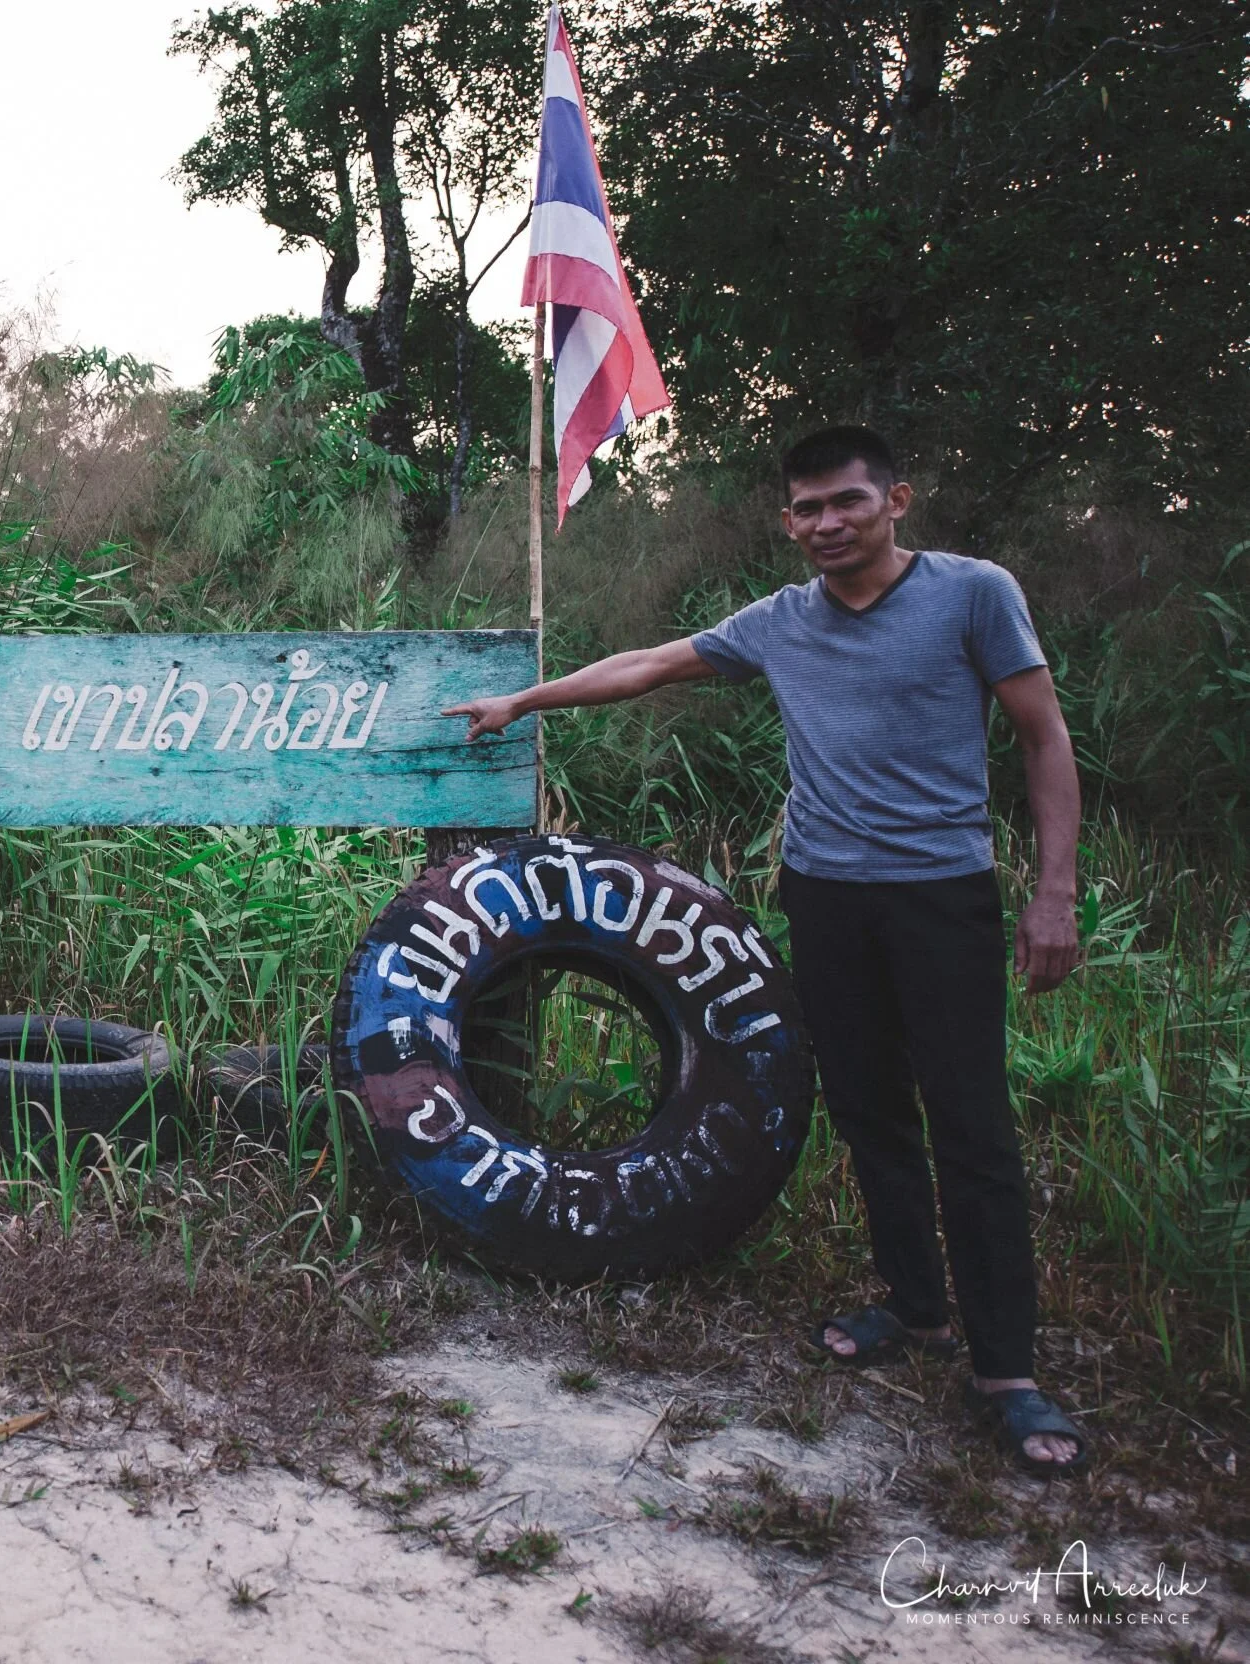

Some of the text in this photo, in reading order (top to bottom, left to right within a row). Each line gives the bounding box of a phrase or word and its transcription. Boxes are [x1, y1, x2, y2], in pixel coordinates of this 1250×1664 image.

[22, 649, 389, 750] เขาปลาน้อย
[376, 836, 781, 1045] ยินดีต้อนรับ
